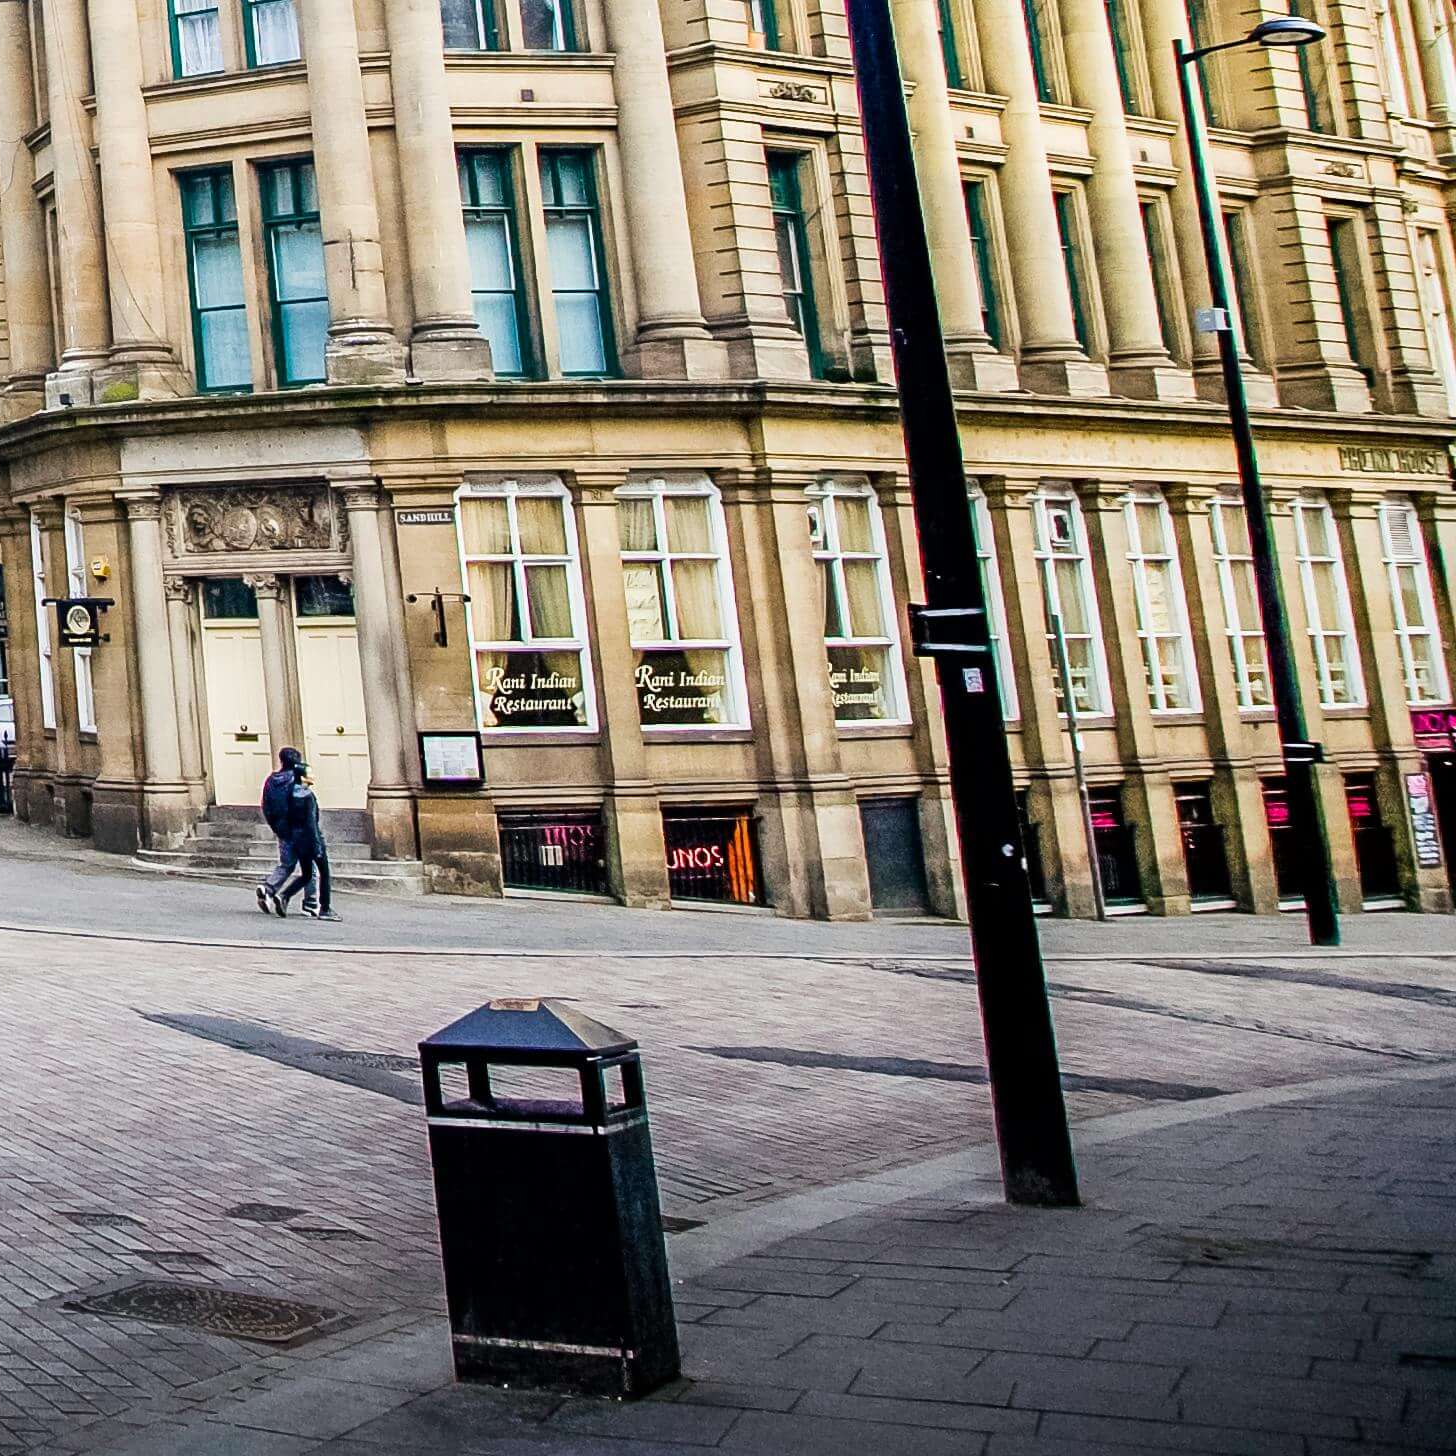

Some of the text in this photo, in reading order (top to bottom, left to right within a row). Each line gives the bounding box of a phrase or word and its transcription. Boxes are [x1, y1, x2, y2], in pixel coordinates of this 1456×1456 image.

[399, 512, 452, 523] SANDHILL
[486, 667, 576, 695] Rani Indian
[634, 664, 725, 693] Rani Indian
[494, 696, 573, 715] Restaurant
